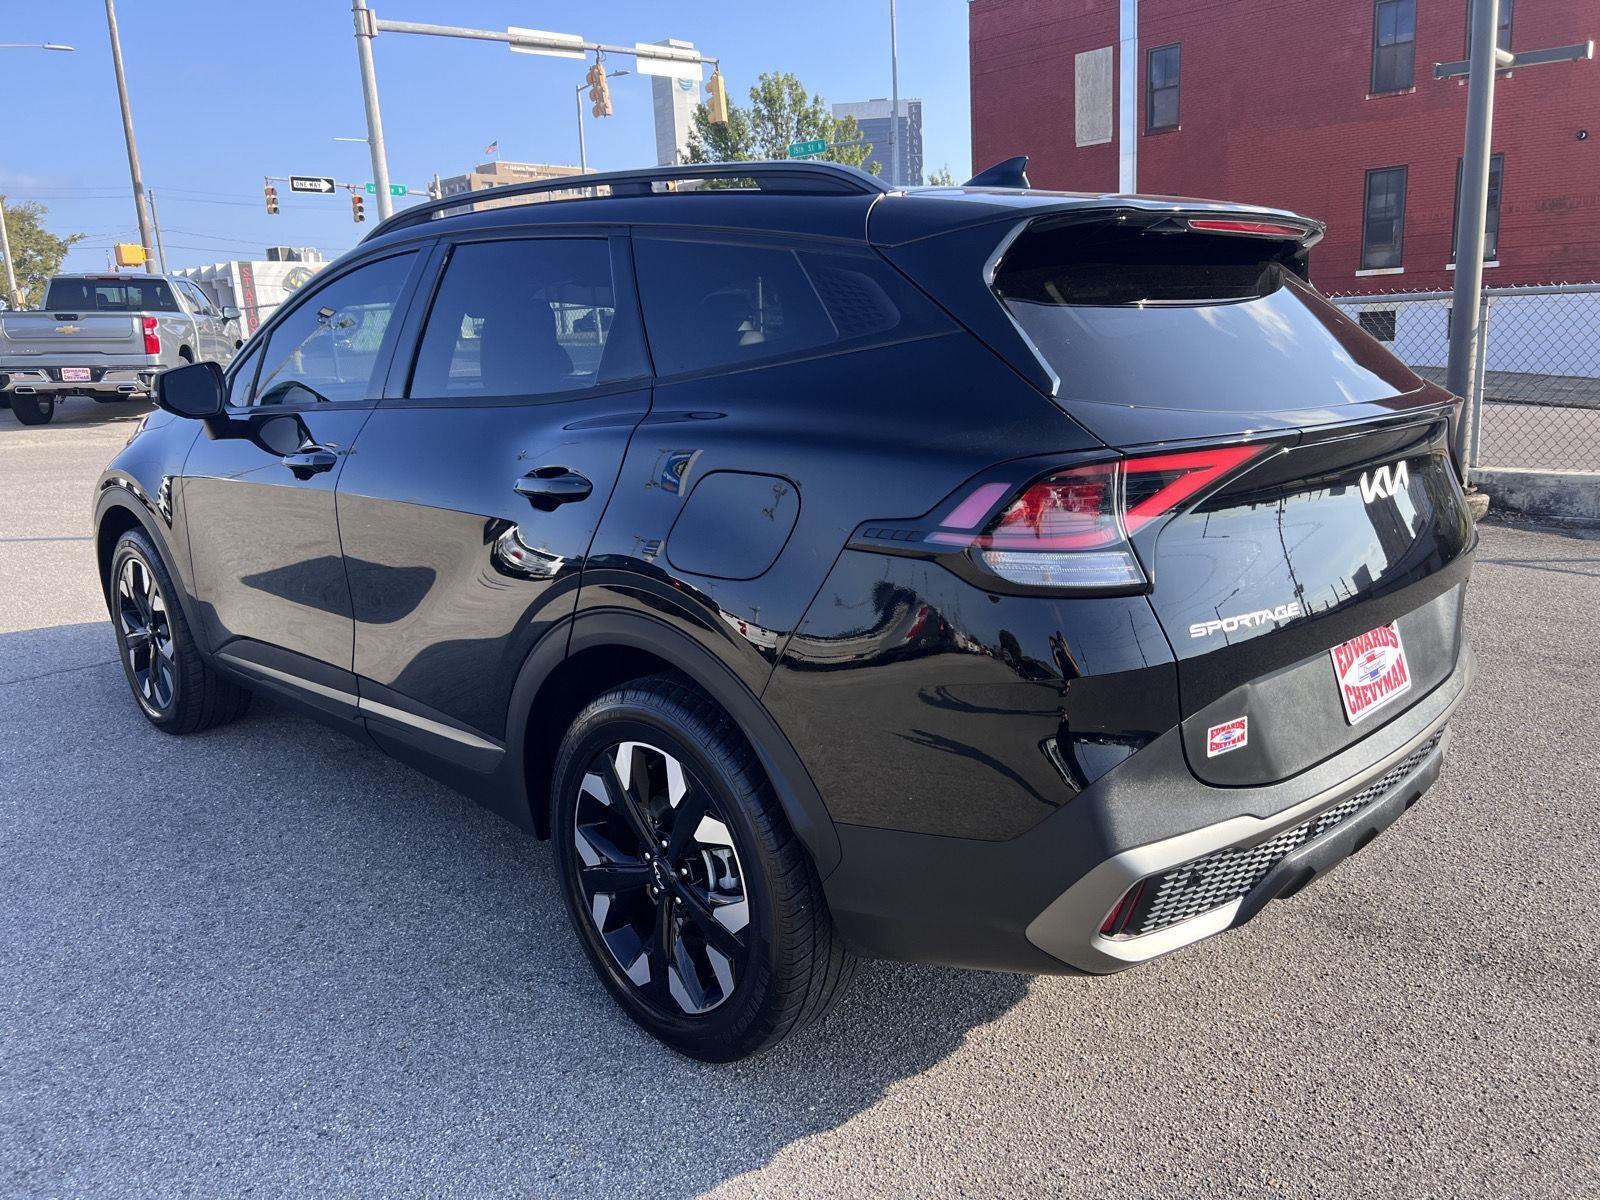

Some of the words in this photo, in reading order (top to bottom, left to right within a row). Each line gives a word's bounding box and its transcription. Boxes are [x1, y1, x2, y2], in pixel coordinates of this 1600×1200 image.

[1189, 602, 1301, 639] SPORTAGE
[1333, 623, 1399, 680] EDWARDS
[1344, 653, 1408, 715] CHEVYMAN
[1210, 719, 1246, 740] EDWARDS
[1210, 731, 1246, 752] CHEVYMAN
